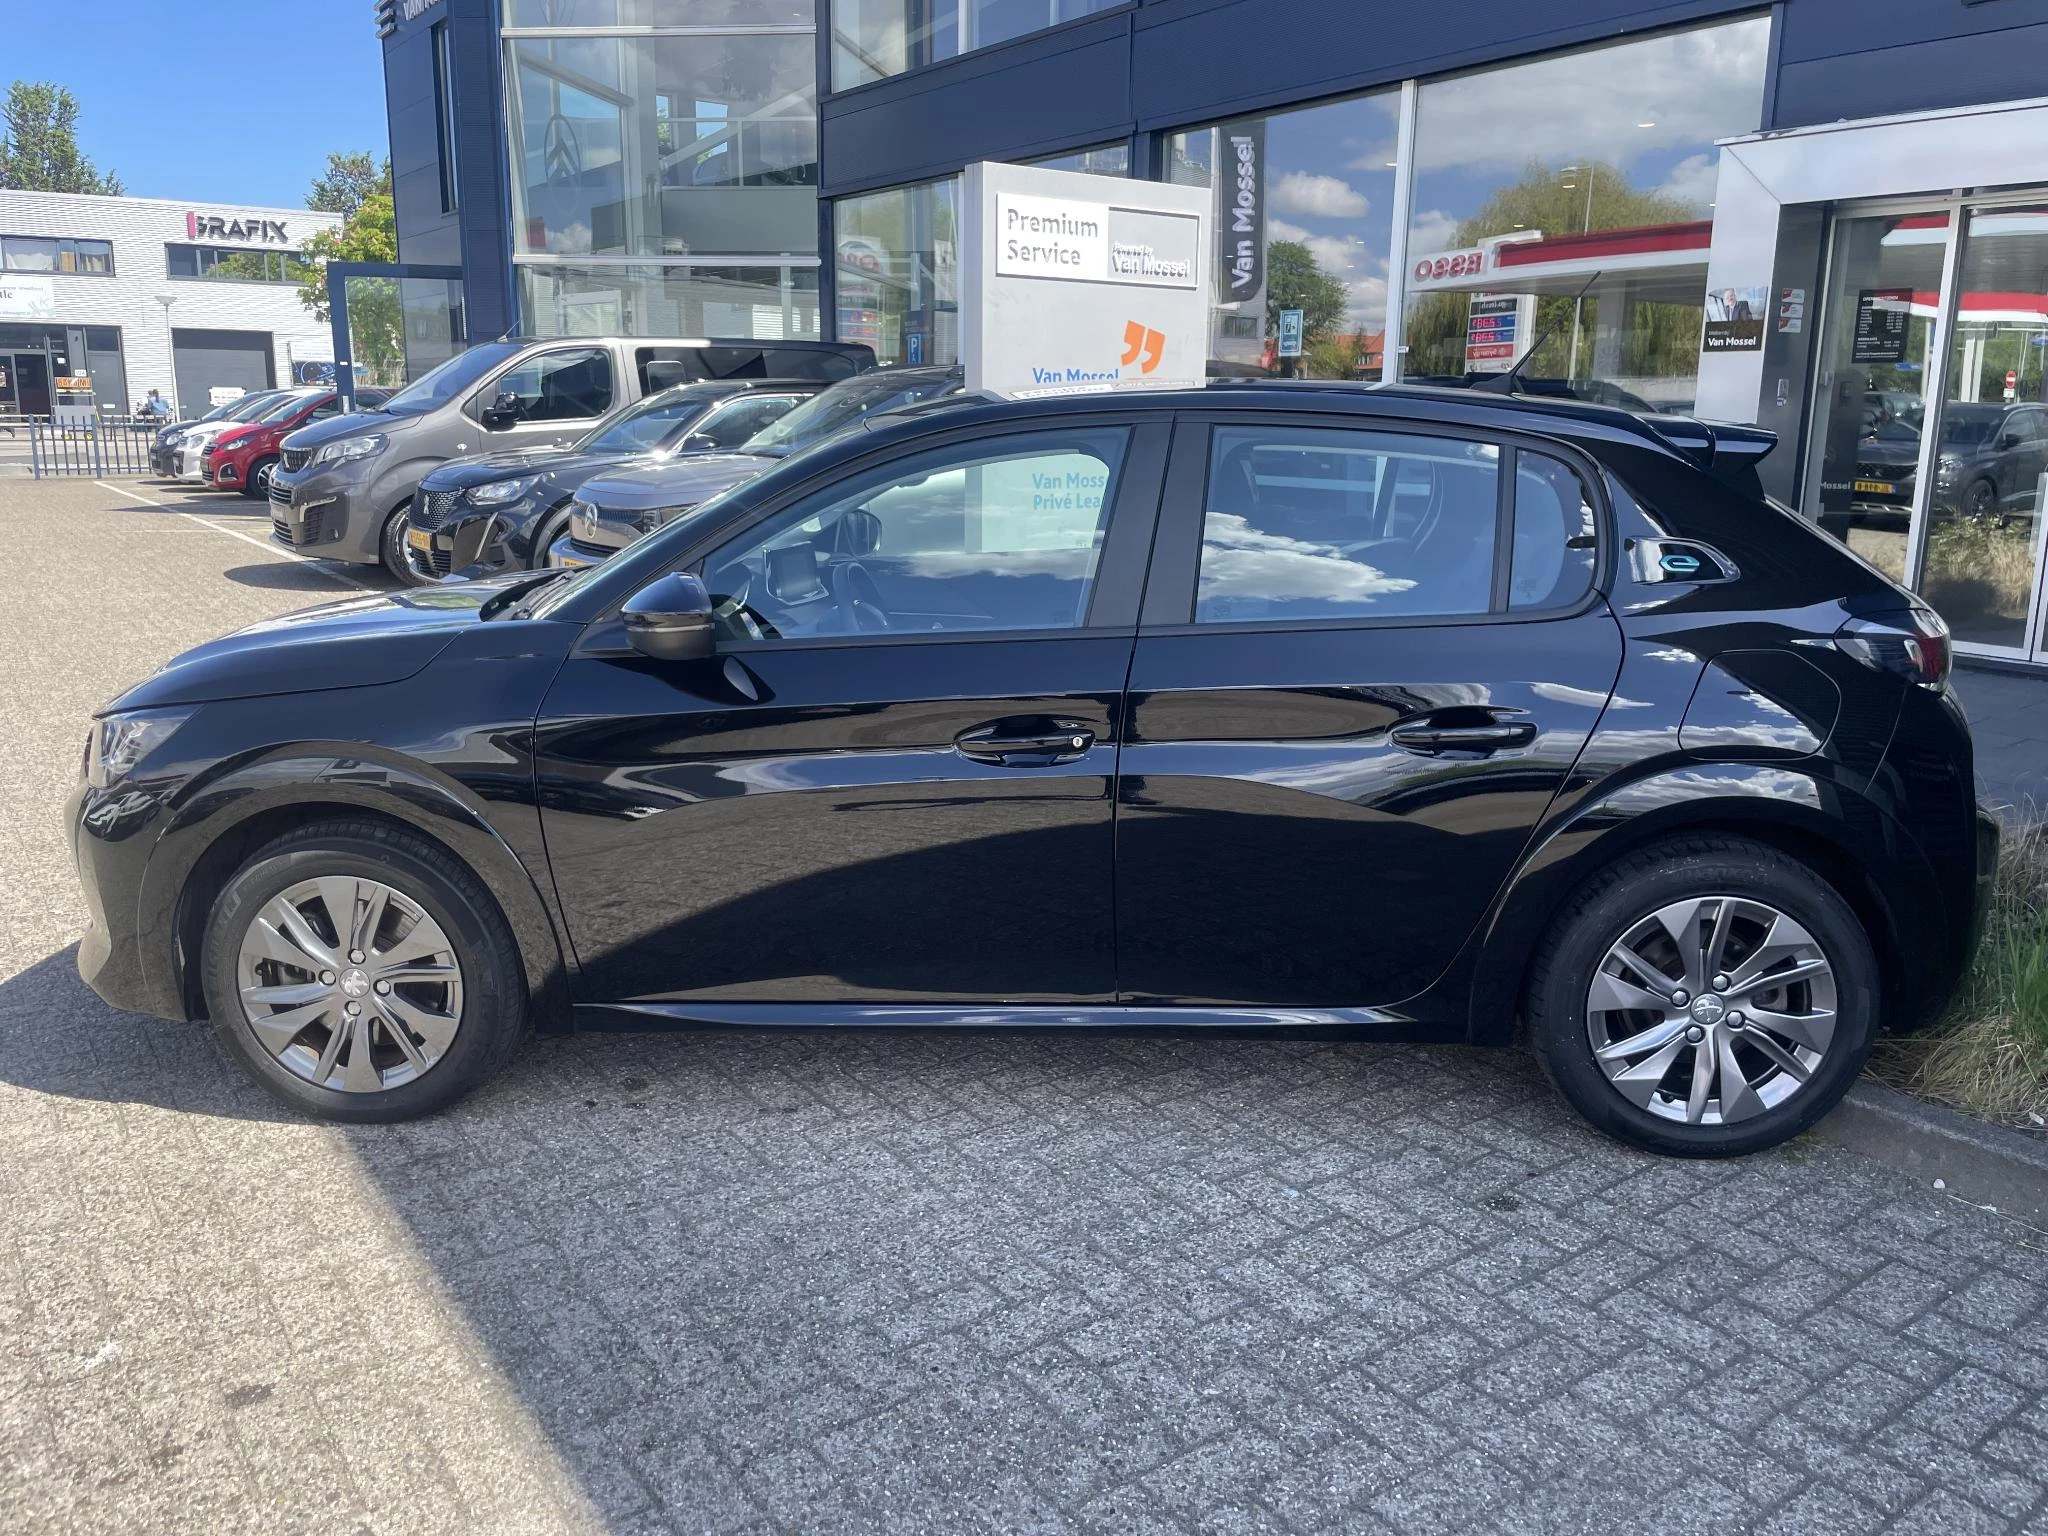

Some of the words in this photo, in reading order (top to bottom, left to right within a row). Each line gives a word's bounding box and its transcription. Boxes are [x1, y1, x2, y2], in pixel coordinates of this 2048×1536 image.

[1231, 136, 1255, 232] Mossel
[1007, 208, 1098, 238] Premium
[1007, 239, 1081, 265] Service
[1112, 252, 1140, 274] Van
[1142, 254, 1190, 278] Mossel
[1232, 240, 1254, 289] Van
[1708, 337, 1724, 347] Van
[1725, 335, 1757, 346] Mossel
[1032, 367, 1062, 384] Van
[1032, 473, 1061, 489] Van
[1066, 472, 1105, 488] Moss
[1033, 493, 1073, 510] Privé
[1076, 493, 1101, 509] Lea
